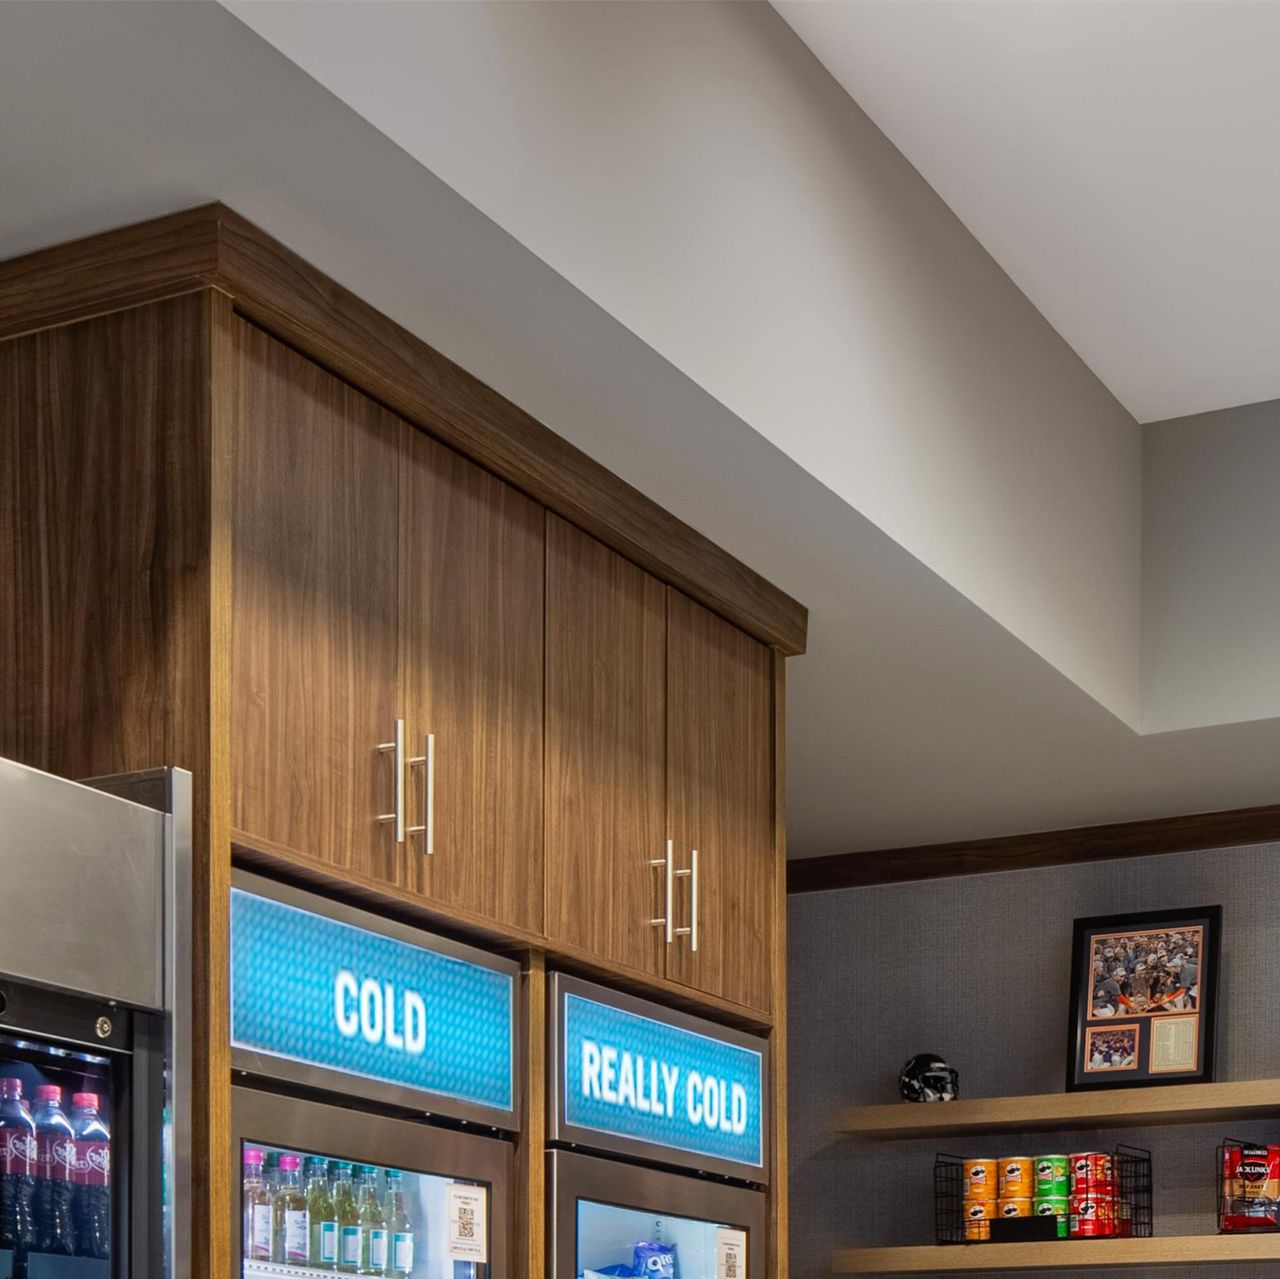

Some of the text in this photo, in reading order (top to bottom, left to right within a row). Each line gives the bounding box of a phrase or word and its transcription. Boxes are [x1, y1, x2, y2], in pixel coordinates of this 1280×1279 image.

[334, 970, 427, 1054] COLD
[582, 1039, 747, 1136] REALLY COLD
